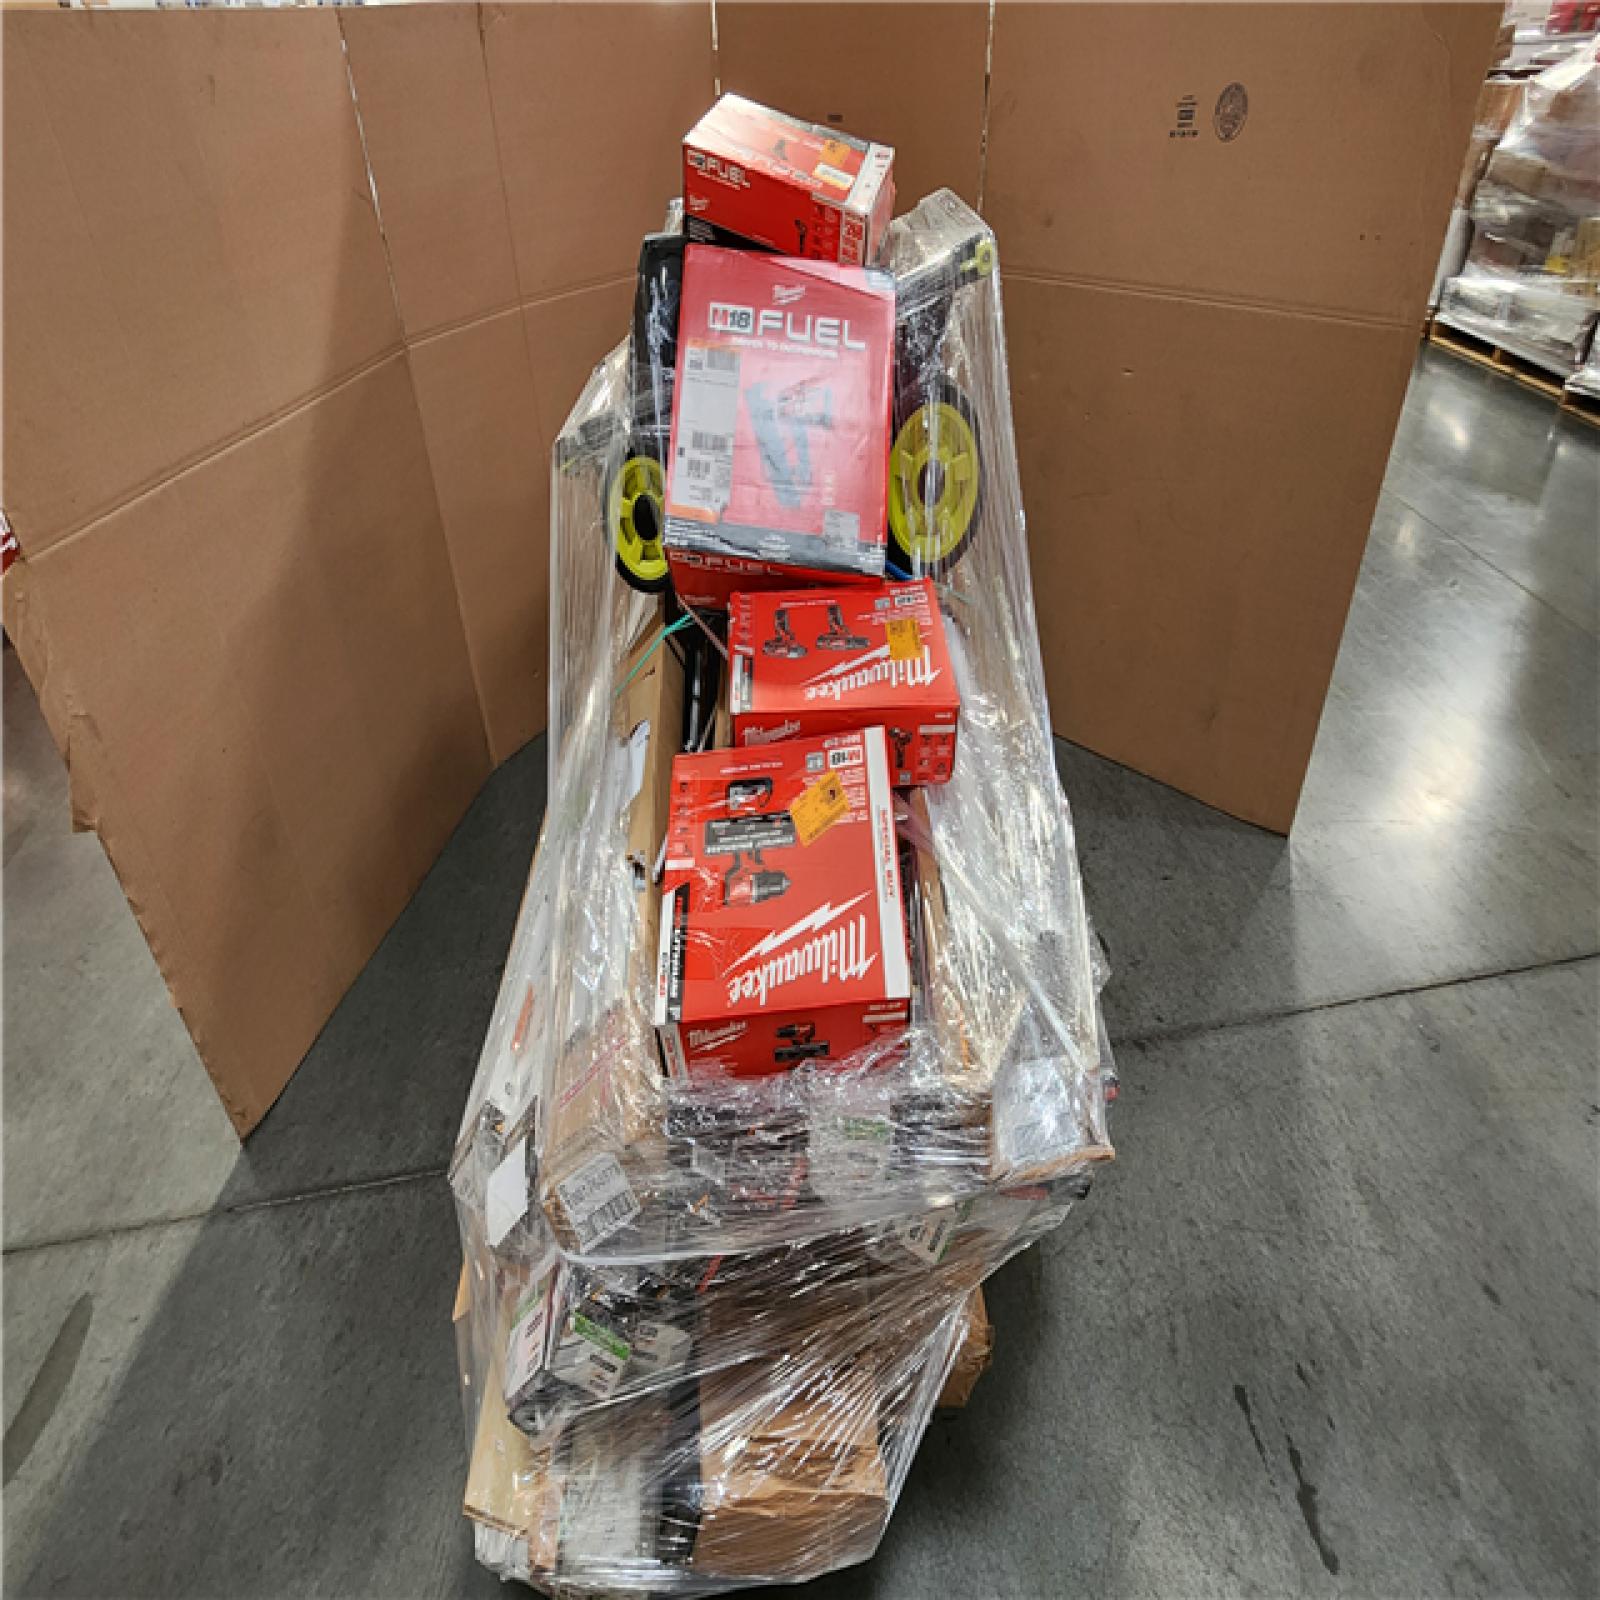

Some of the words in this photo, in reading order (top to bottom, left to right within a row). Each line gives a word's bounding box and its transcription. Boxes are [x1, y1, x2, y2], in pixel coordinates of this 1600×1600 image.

[710, 304, 753, 331] M18
[757, 309, 866, 350] FUEL
[803, 644, 942, 700] Milwaukee
[726, 914, 879, 1007] Milwaukee
[687, 1020, 747, 1050] Milwaukee
